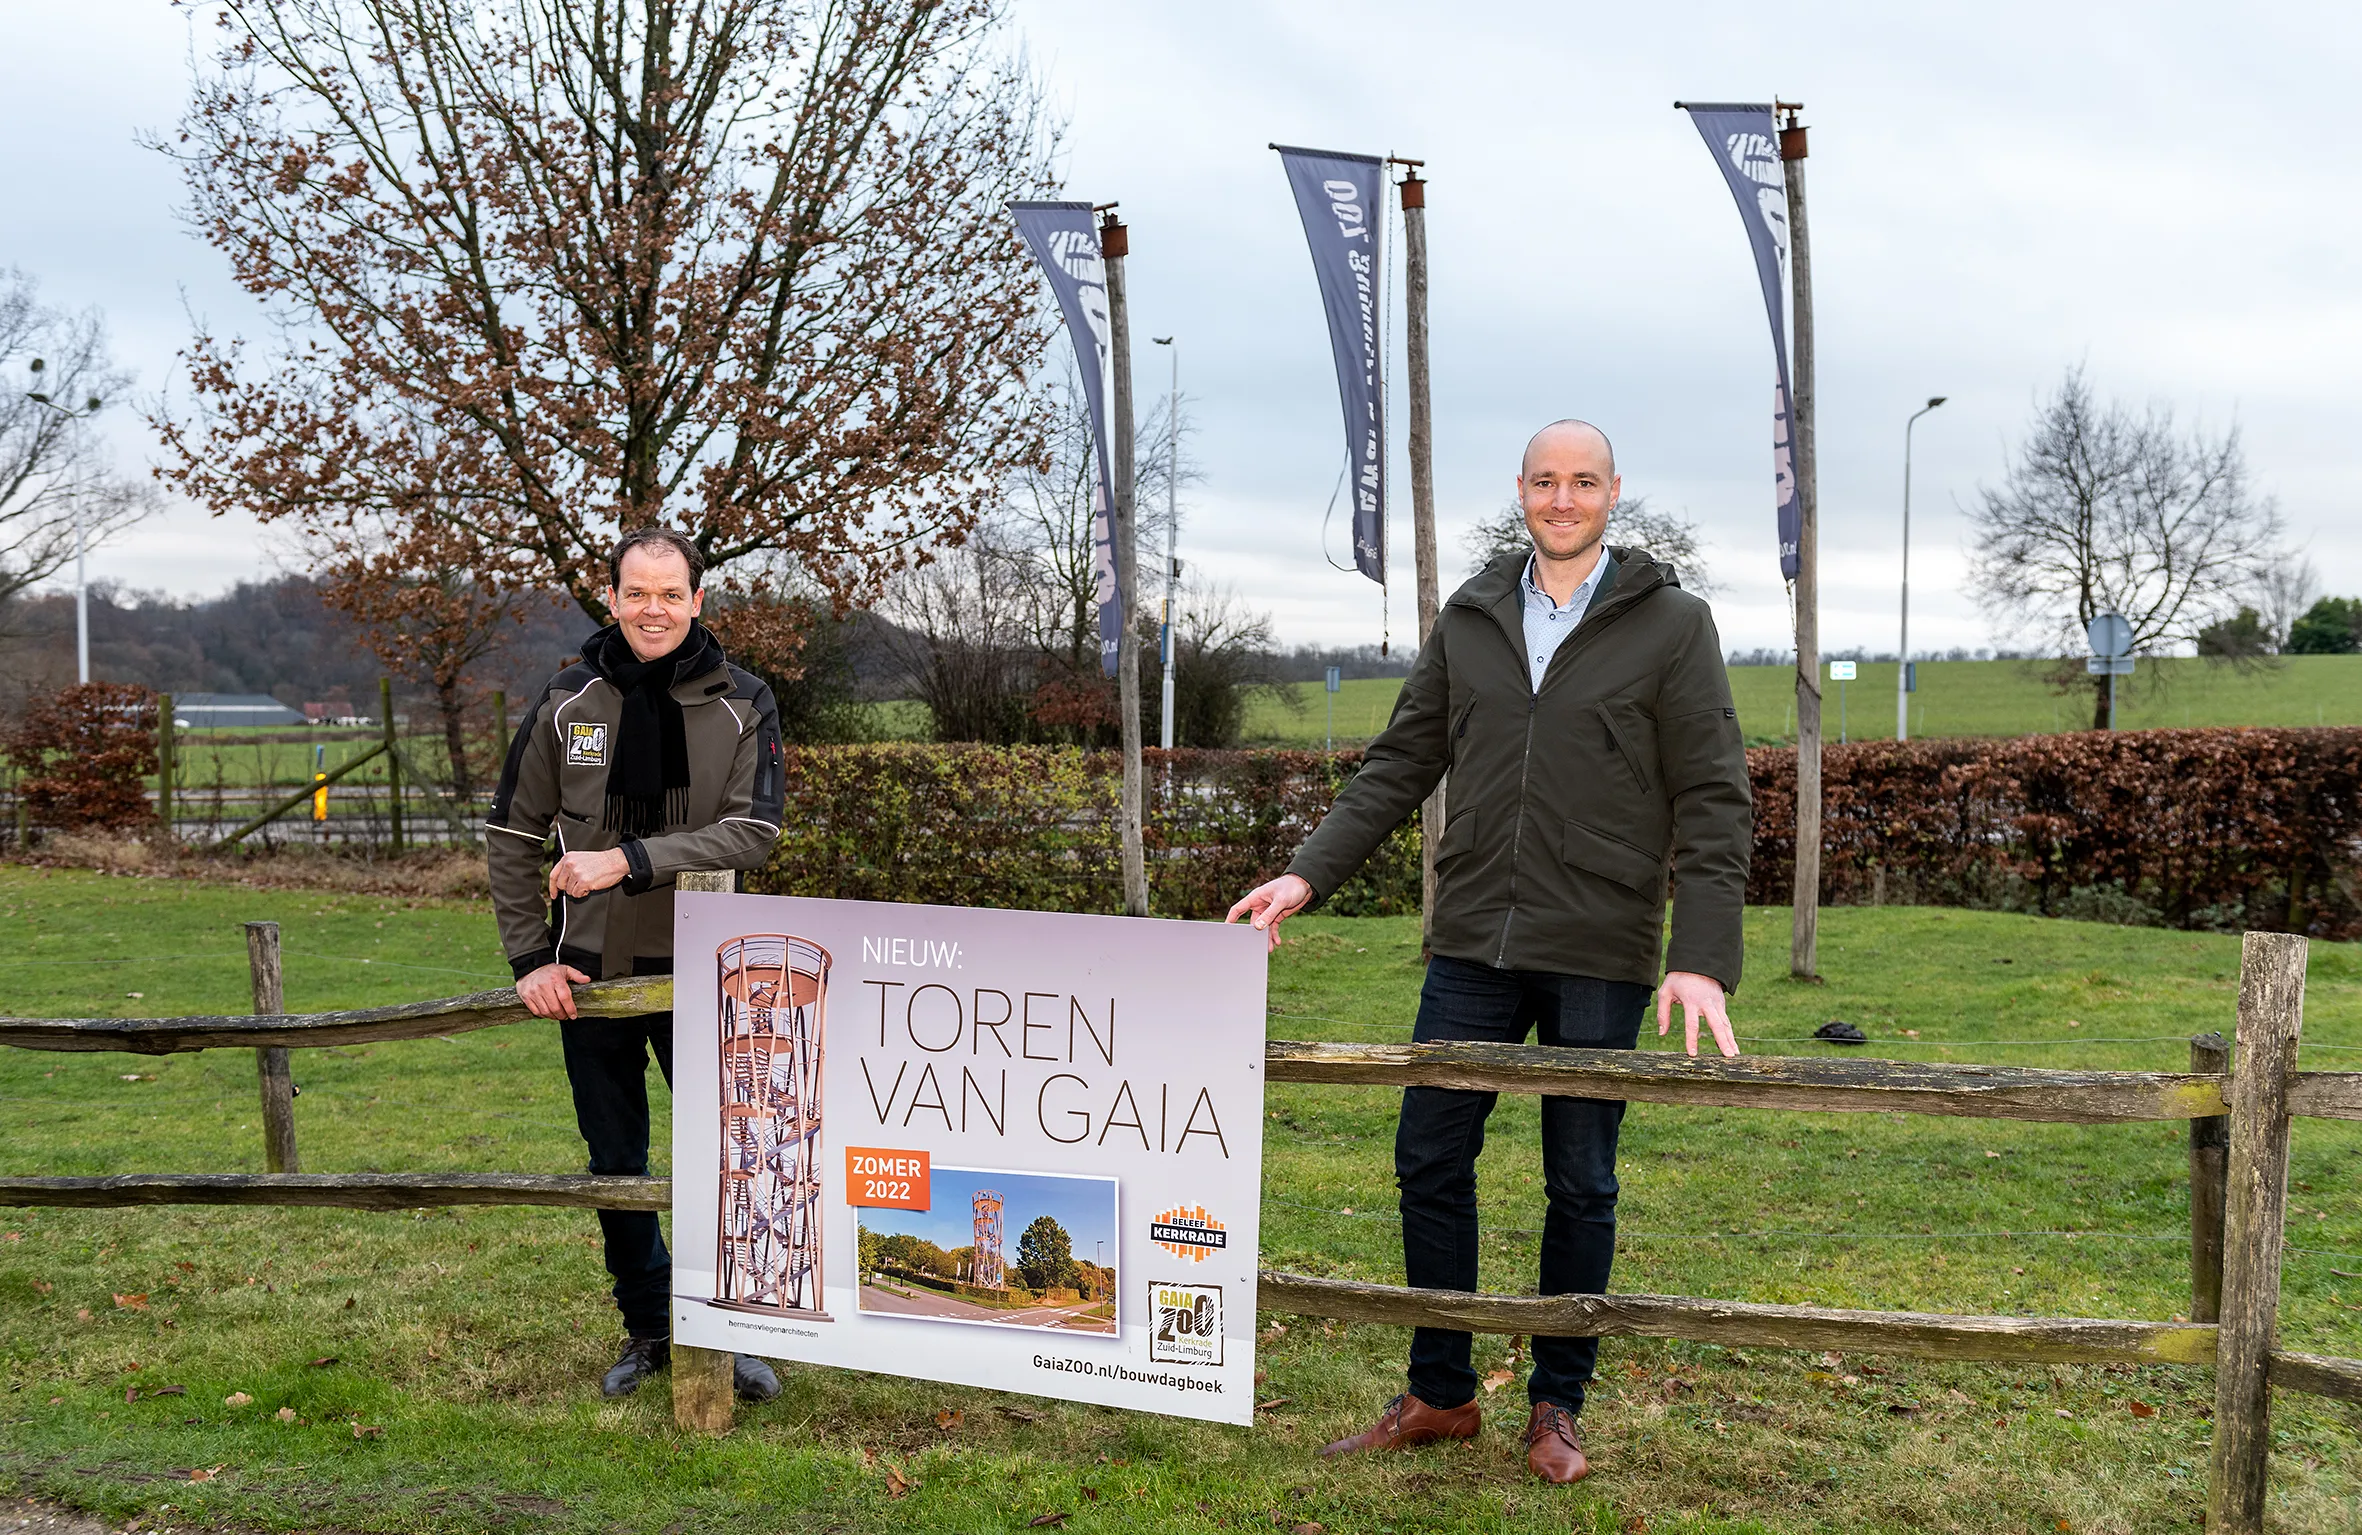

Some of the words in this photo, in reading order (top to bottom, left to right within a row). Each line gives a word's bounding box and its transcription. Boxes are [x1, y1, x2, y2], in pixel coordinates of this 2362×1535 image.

[862, 936, 963, 970] NIEUW:
[862, 979, 1115, 1067] TOREN
[860, 1056, 1006, 1137] VAN
[1037, 1073, 1230, 1160] GAIA
[852, 1155, 922, 1178] ZOMER
[865, 1179, 911, 1200] 2022
[1172, 1217, 1206, 1228] BELEEF
[1153, 1226, 1224, 1245] KERKRADE
[1159, 1289, 1193, 1309] GAIA
[728, 1319, 819, 1338] hermansvliegenarchitecten
[1157, 1341, 1213, 1360] Zuid-Limburg
[1178, 1335, 1213, 1348] Kerkrade
[1033, 1354, 1223, 1394] GaiaZOO.nl/bouwdagboek
